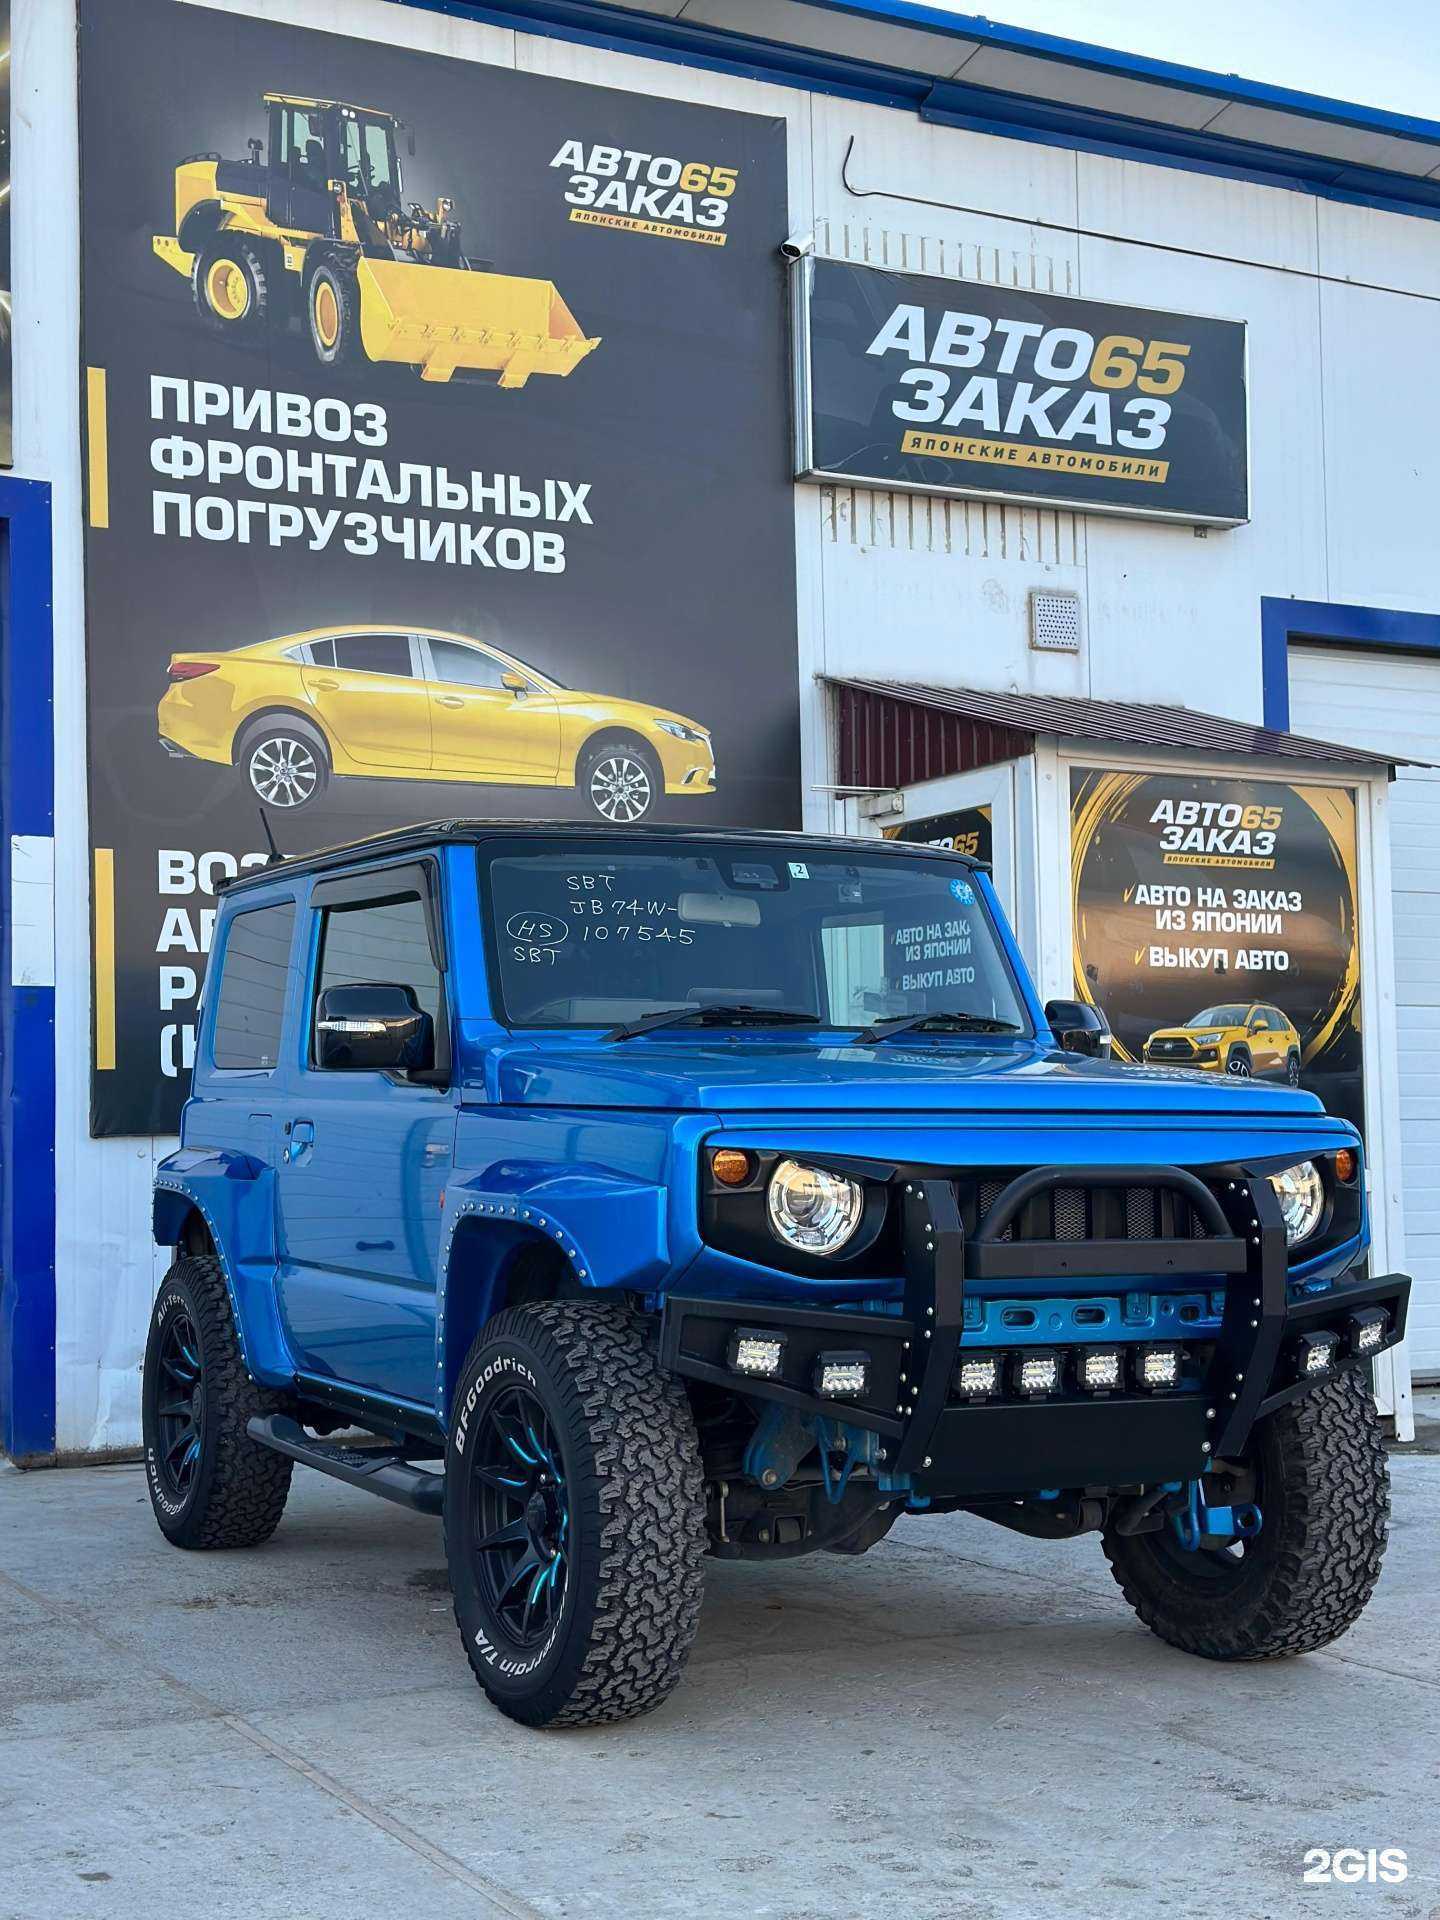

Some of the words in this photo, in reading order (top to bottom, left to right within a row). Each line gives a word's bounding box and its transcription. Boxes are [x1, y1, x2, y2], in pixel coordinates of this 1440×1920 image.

[549, 140, 739, 197] АВТО65
[564, 175, 729, 227] ЗАКАЗ
[574, 212, 638, 229] ЯПОНСКИЕ
[643, 224, 722, 243] АВТОМОБИЛИ
[865, 304, 1191, 395] АВТО65
[149, 374, 388, 447] ПРИВОЗ
[891, 368, 1172, 450] ЗАКАЗ
[910, 437, 1018, 461] ЯПОНСКИЕ
[1027, 451, 1160, 477] АВТОМОБИЛИ
[149, 434, 594, 525] ФРОНТАЛЬНЫХ
[152, 490, 567, 574] ПОГРУЗЧИКОВ
[1149, 799, 1283, 830] АВТО65
[1160, 826, 1277, 856] ЗАКАЗ
[566, 875, 616, 891] SBT
[1135, 885, 1191, 908] АВТО
[1197, 888, 1227, 909] НА
[1233, 890, 1302, 912] ЗАКАЗ
[583, 926, 696, 945] 107545
[895, 926, 924, 946] АВТО
[926, 923, 942, 940] НА
[1155, 910, 1186, 931] ИЗ
[1192, 912, 1282, 935] ЯПОНИИ
[513, 946, 562, 966] SBT
[905, 945, 921, 962] ИЗ
[923, 937, 971, 960] ЯПОНИИ
[1149, 946, 1229, 969] ВЫКУП
[1234, 949, 1289, 971] АВТО
[902, 970, 943, 991] ВЫКУП
[945, 966, 975, 986] АВТО
[455, 1355, 537, 1455] BFGoodrich
